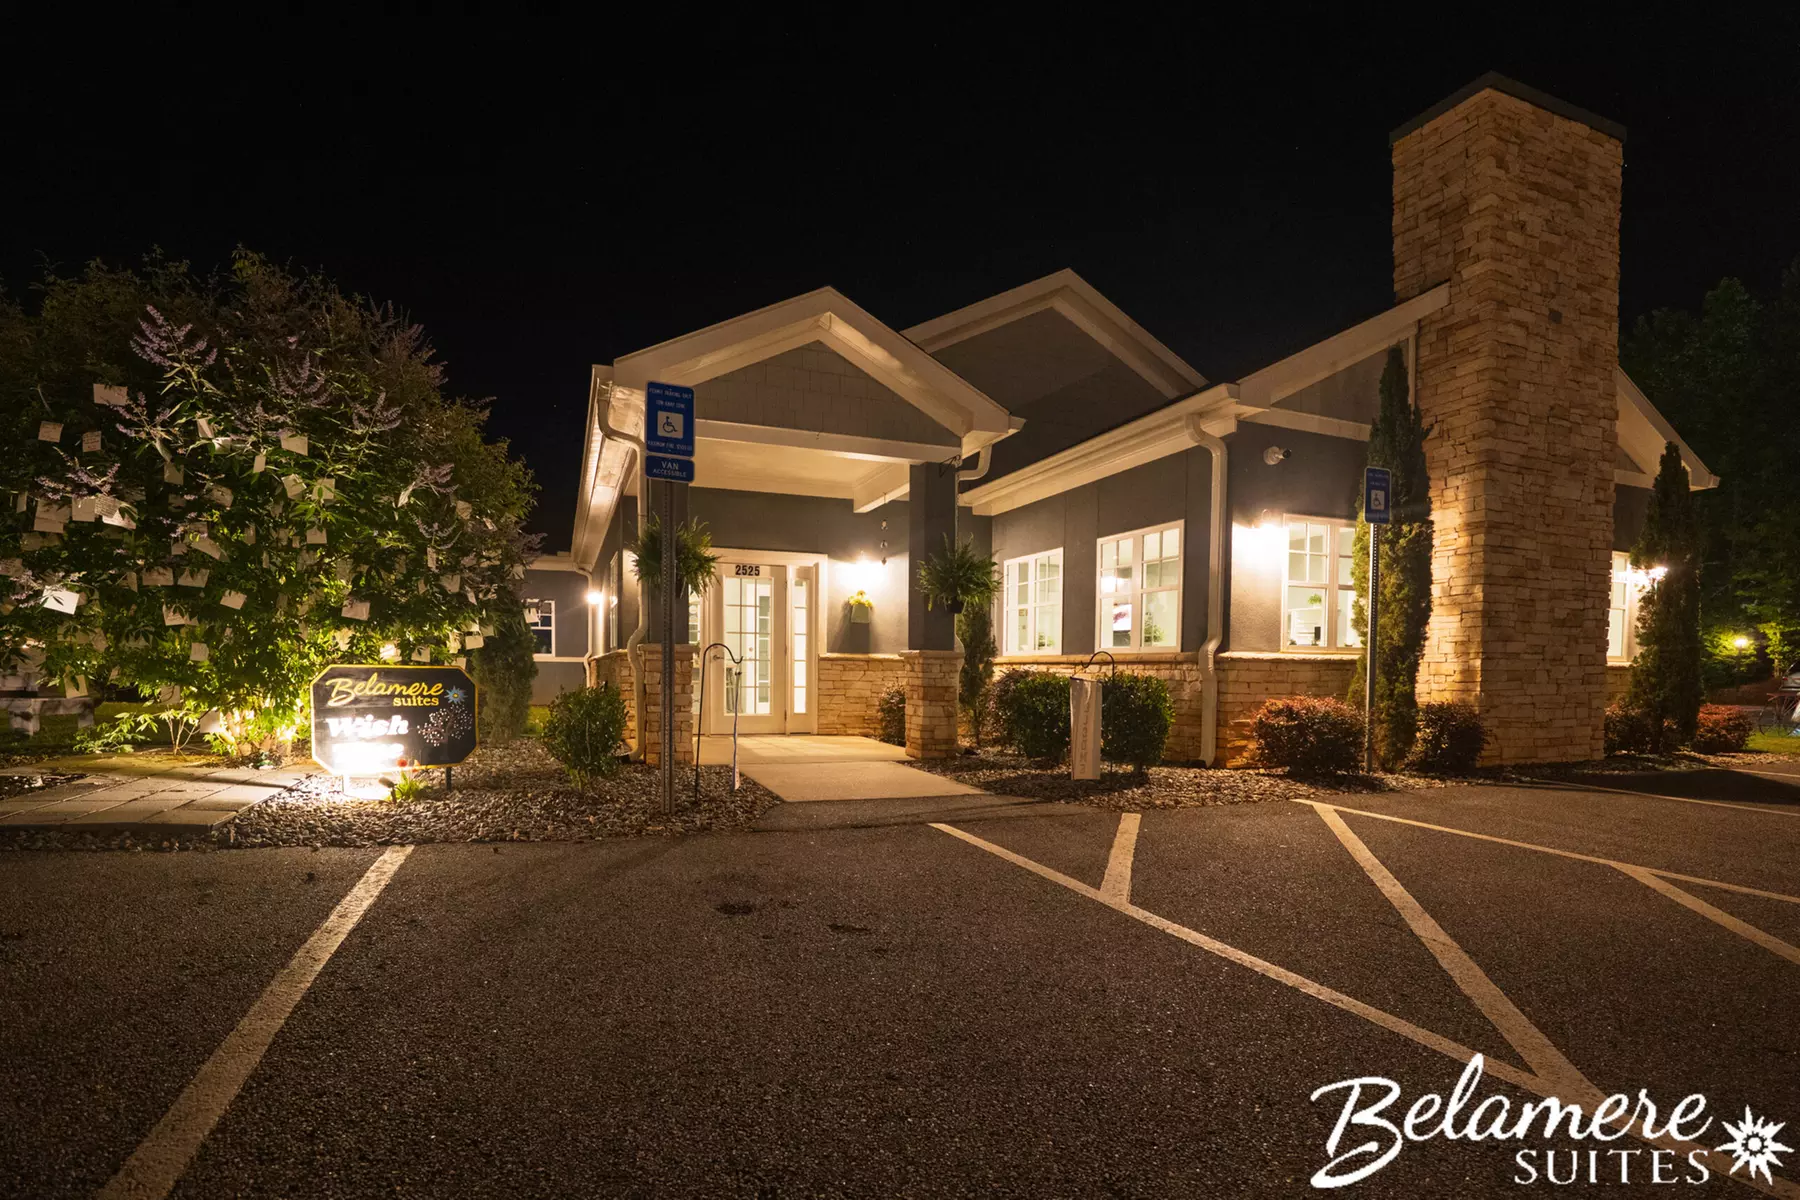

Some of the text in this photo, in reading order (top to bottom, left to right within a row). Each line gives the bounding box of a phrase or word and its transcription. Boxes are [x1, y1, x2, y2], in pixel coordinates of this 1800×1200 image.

[661, 461, 679, 470] VAN
[652, 468, 687, 478] ACCESSIBLE
[735, 564, 760, 576] 2525
[325, 672, 444, 707] Belamere
[393, 695, 440, 707] suites
[324, 714, 409, 738] Wish
